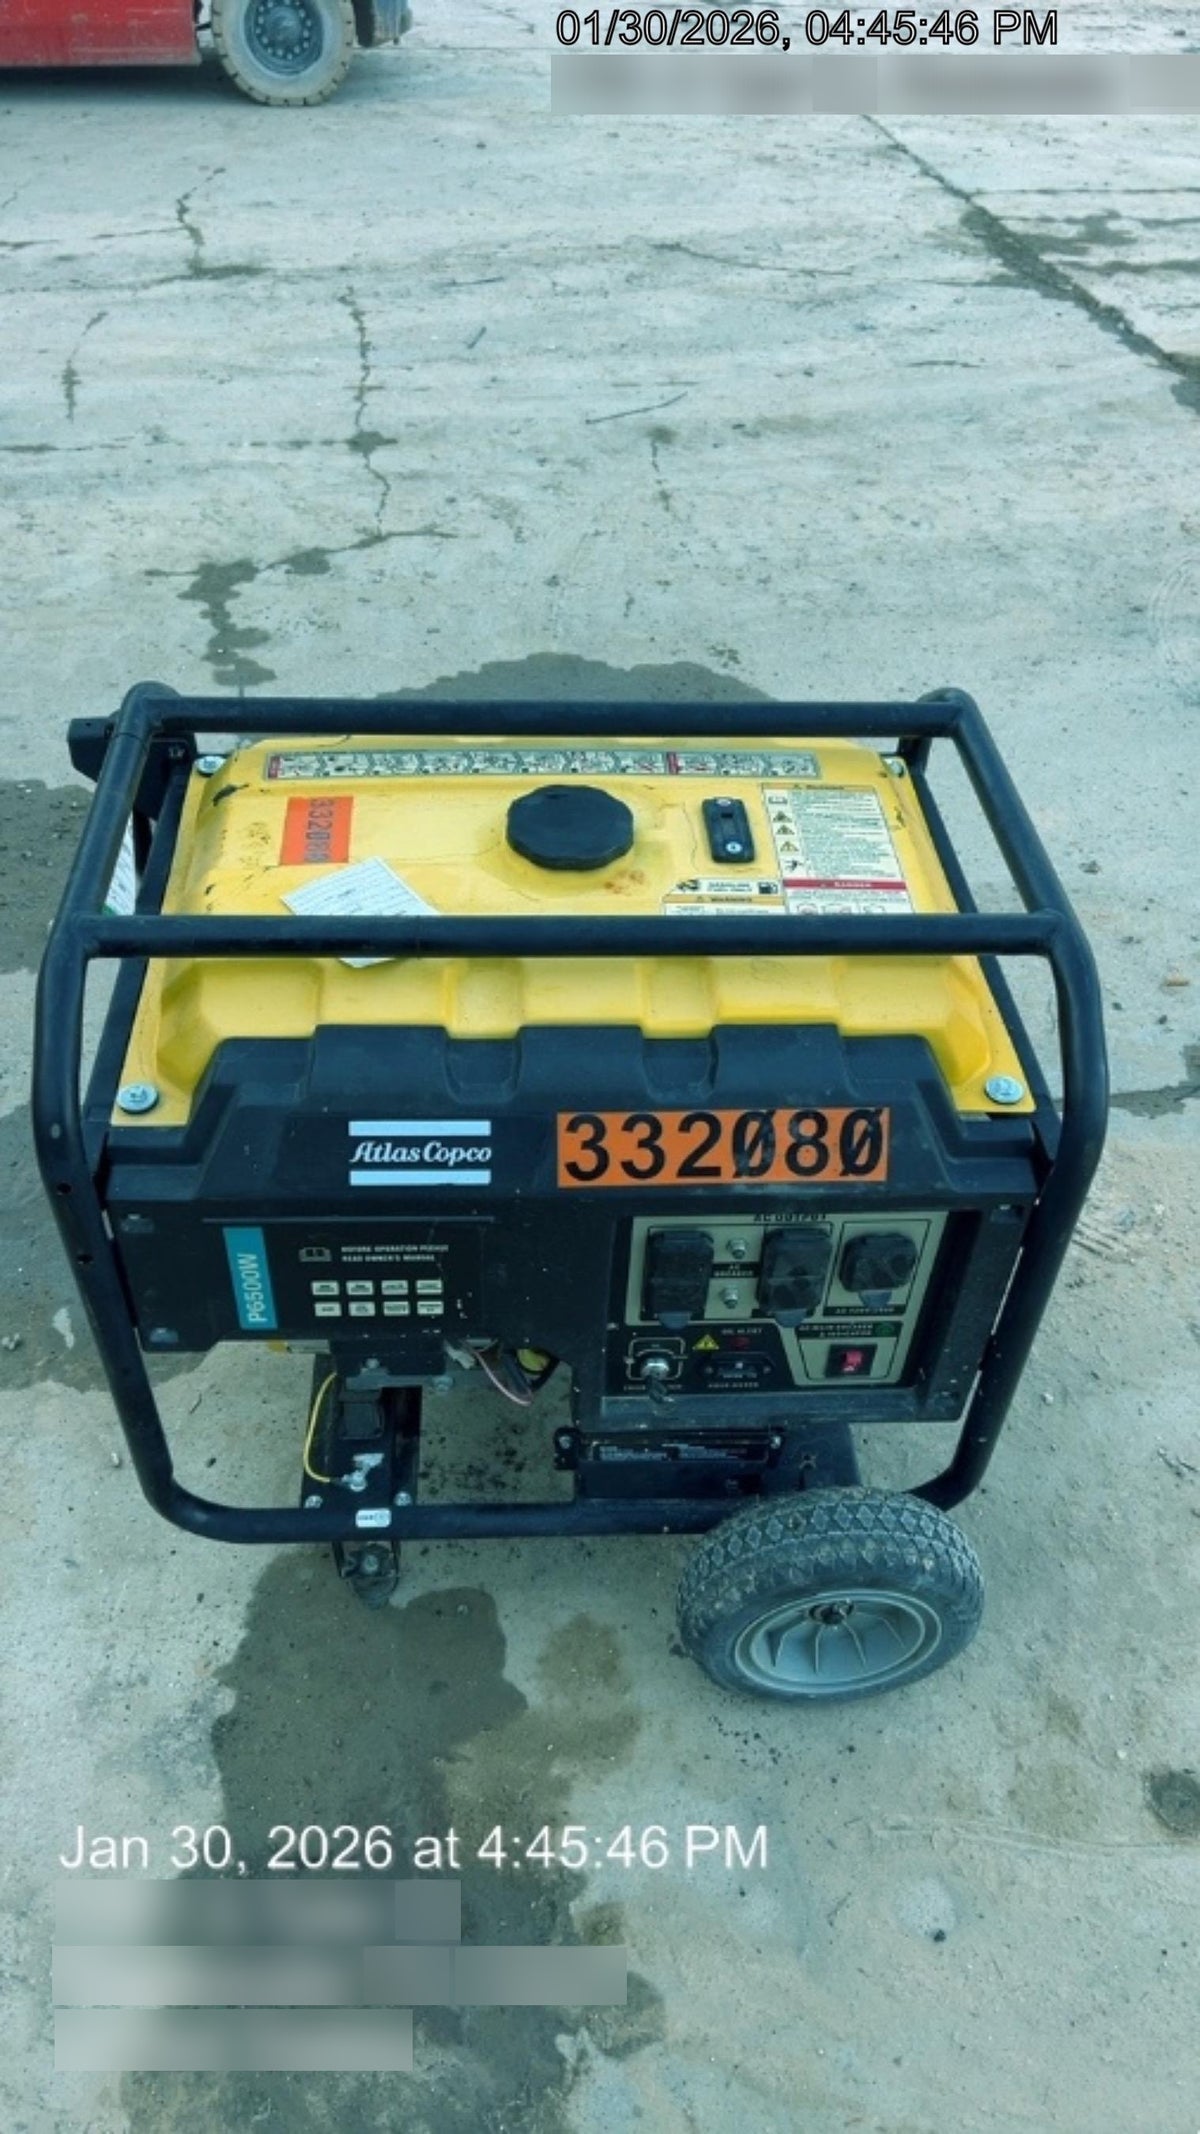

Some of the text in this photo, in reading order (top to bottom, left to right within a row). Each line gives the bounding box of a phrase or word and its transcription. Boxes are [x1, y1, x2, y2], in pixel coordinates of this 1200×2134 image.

[349, 1140, 492, 1166] Atlas Copco
[564, 1108, 884, 1182] 332080
[237, 1252, 268, 1323] P6500W
